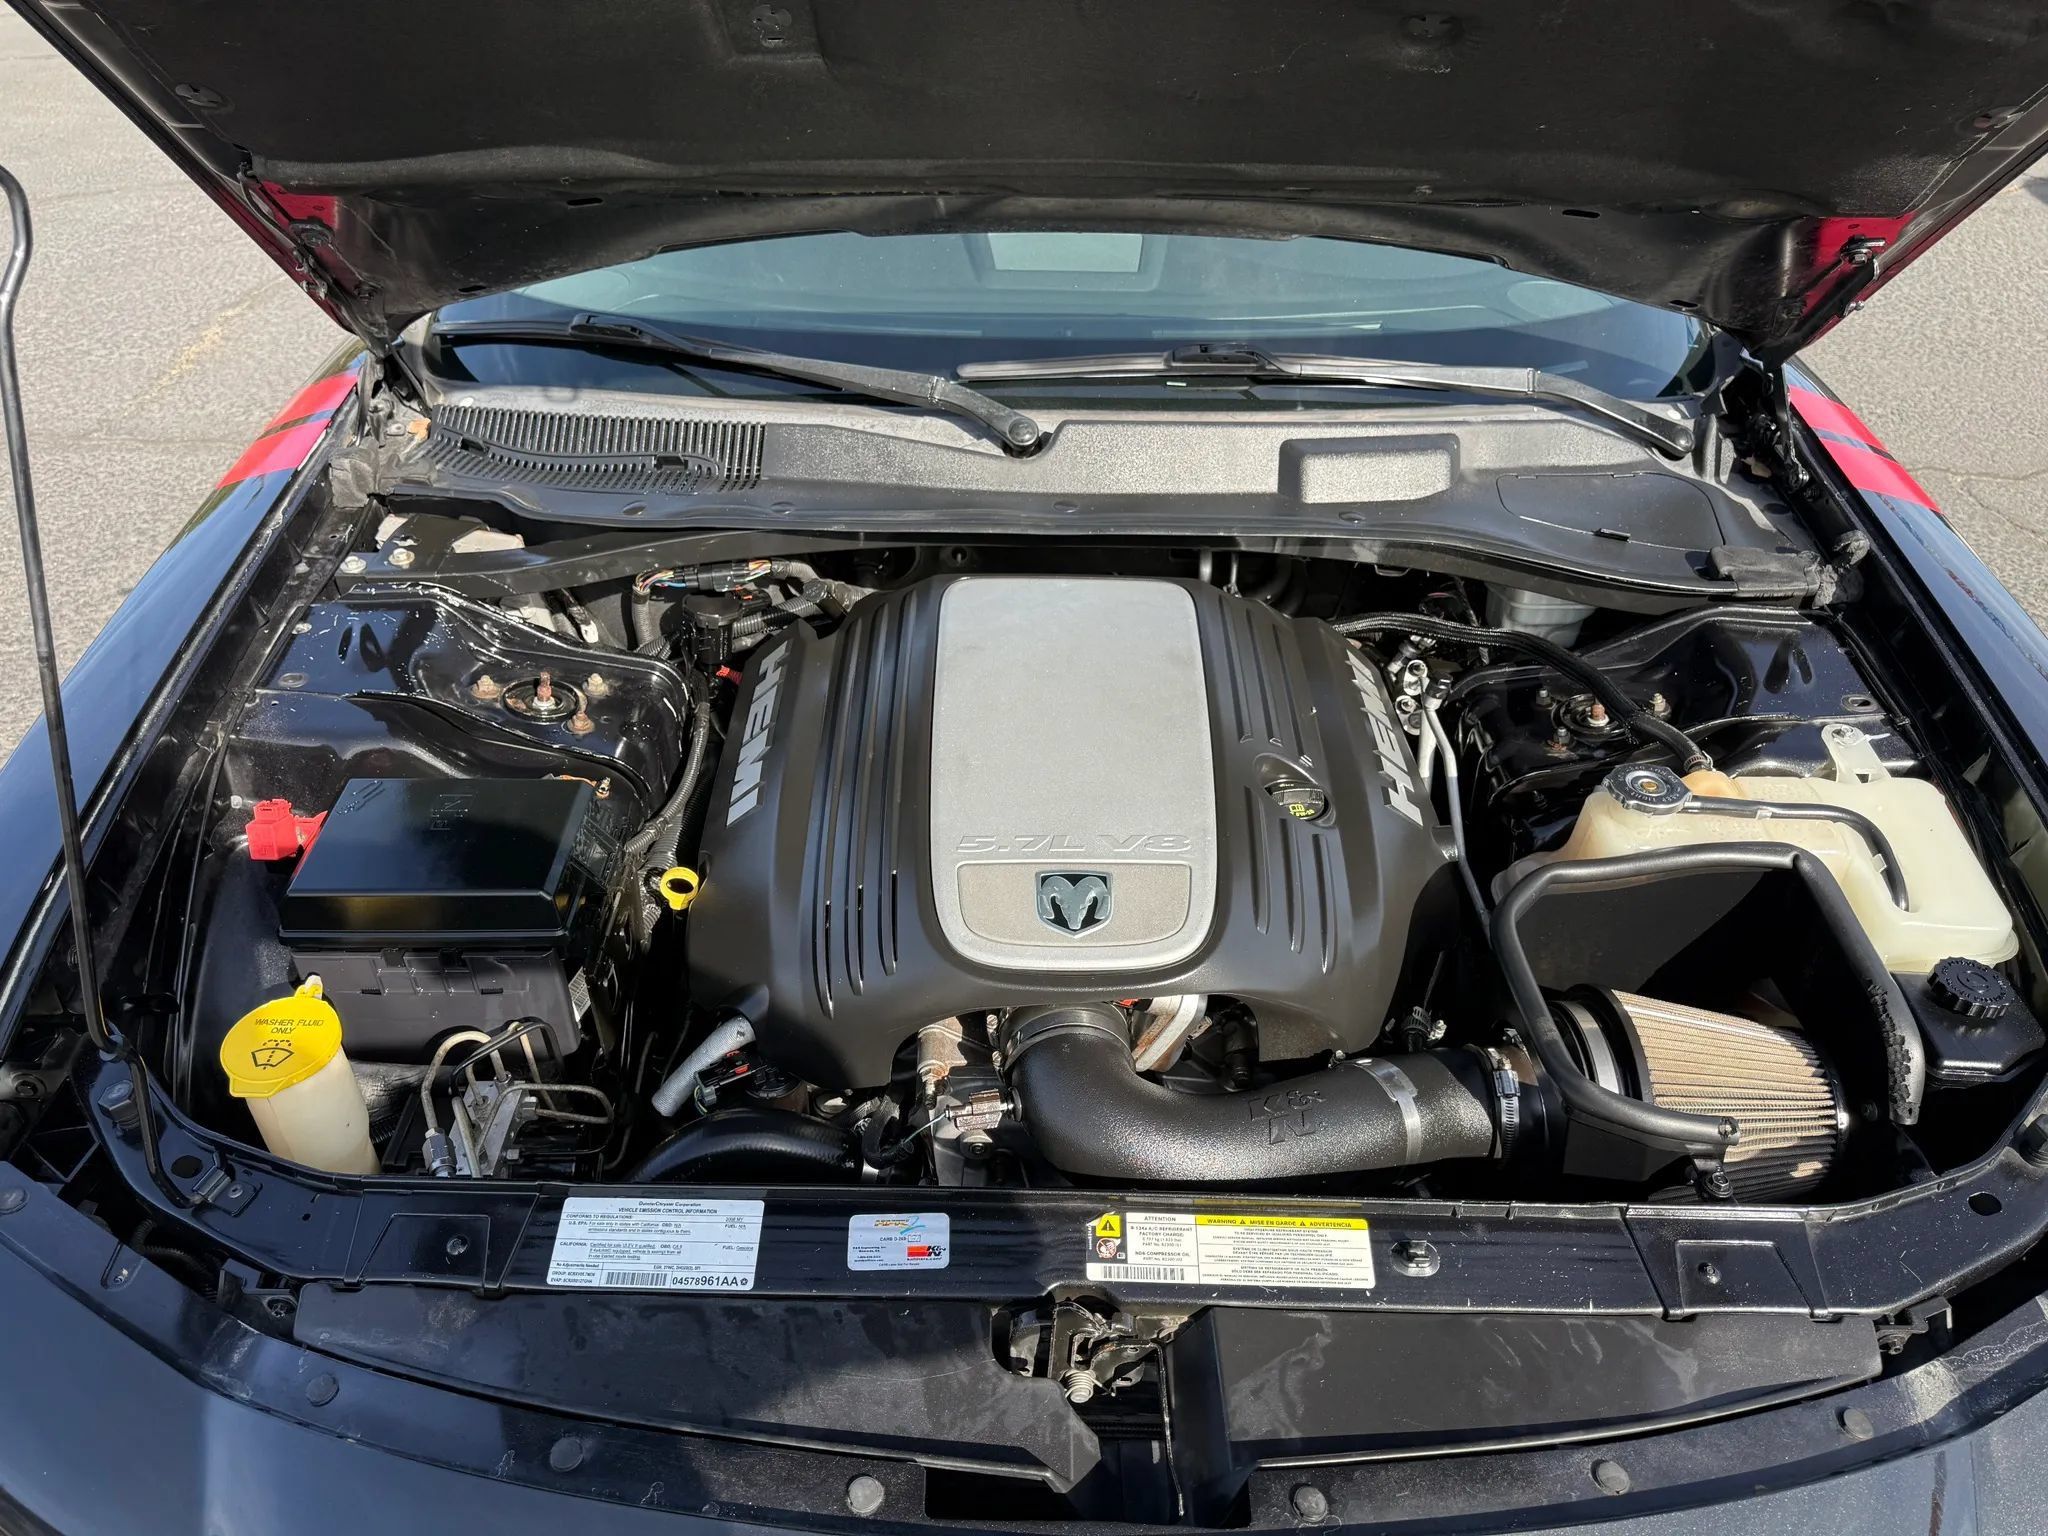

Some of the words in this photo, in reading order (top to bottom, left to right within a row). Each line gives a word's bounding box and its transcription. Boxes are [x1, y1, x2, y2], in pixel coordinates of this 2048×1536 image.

[726, 641, 788, 827] HEMI
[1346, 650, 1424, 827] HEMI
[955, 834, 1087, 852] 5.7L
[1099, 834, 1192, 852] V8
[254, 1018, 295, 1026] WASHER
[296, 1019, 324, 1027] FLUID
[270, 1026, 296, 1034] ONLY
[672, 1276, 738, 1286] 04578961AA
